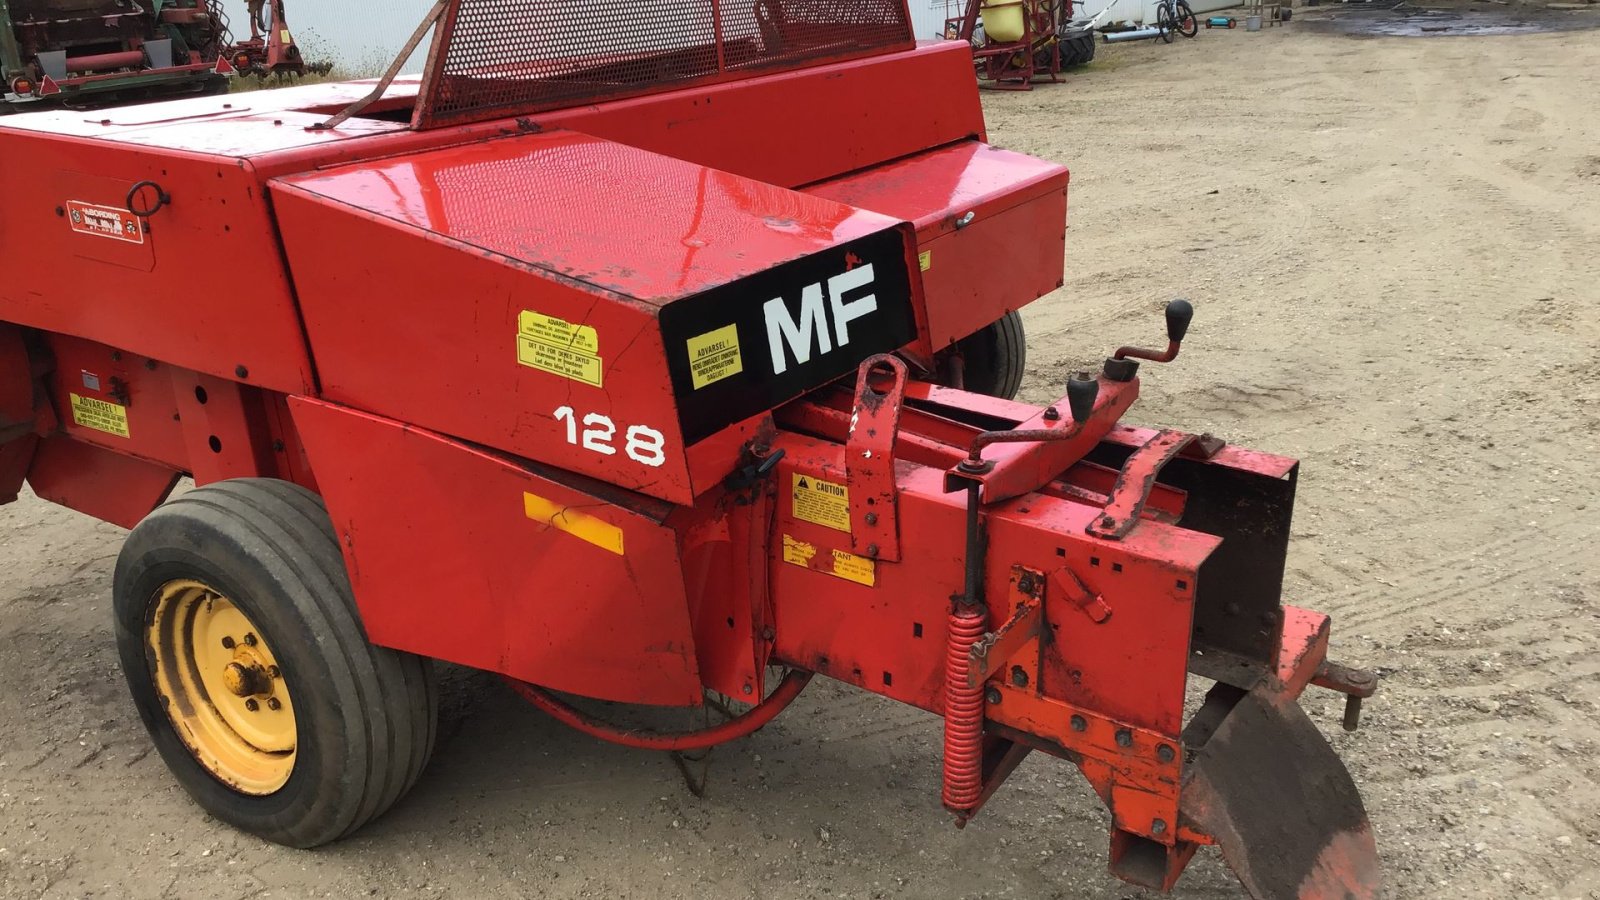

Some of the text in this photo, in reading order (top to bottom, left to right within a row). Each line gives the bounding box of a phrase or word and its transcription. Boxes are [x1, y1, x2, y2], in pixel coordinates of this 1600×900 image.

[763, 262, 878, 375] MF
[528, 341, 536, 349] DET
[547, 347, 556, 355] FOR
[558, 350, 572, 359] DERES
[575, 355, 590, 365] SKYLD
[697, 340, 725, 357] ADVARSEL
[79, 397, 112, 412] ADVARSEL
[553, 405, 666, 467] 128
[816, 481, 844, 497] CAUTION
[834, 550, 851, 561] TANT
